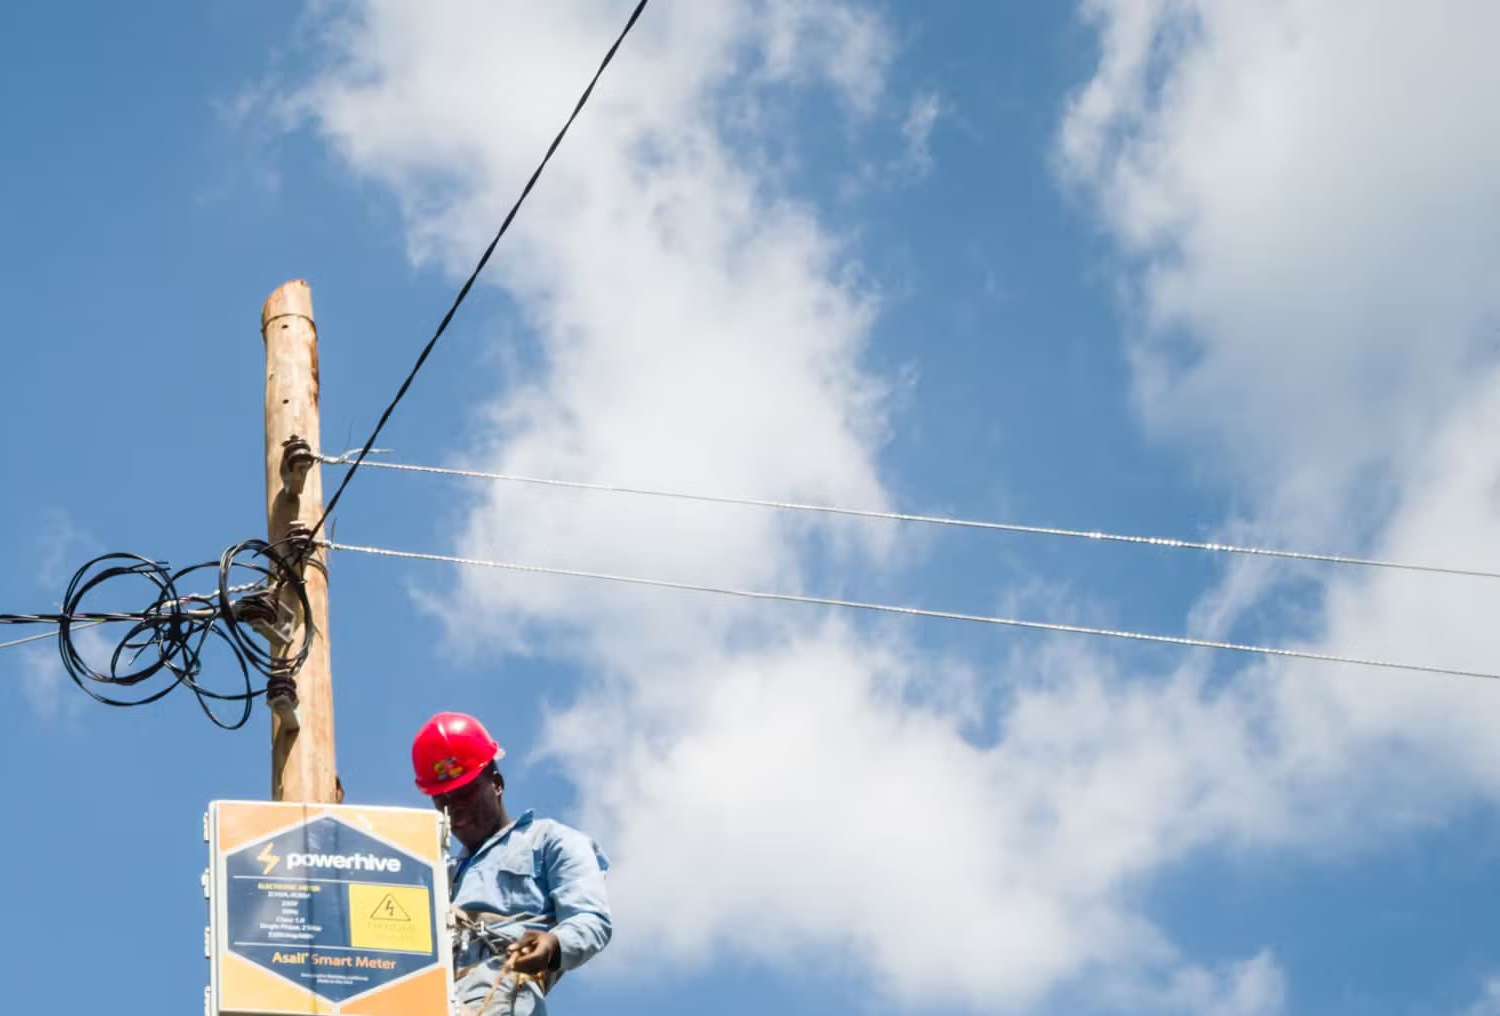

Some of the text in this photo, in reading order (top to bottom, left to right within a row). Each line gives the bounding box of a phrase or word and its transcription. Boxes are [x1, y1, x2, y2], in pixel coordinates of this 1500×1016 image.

[286, 852, 402, 873] powerhive
[311, 953, 353, 967] Smart
[355, 956, 397, 969] Meter
